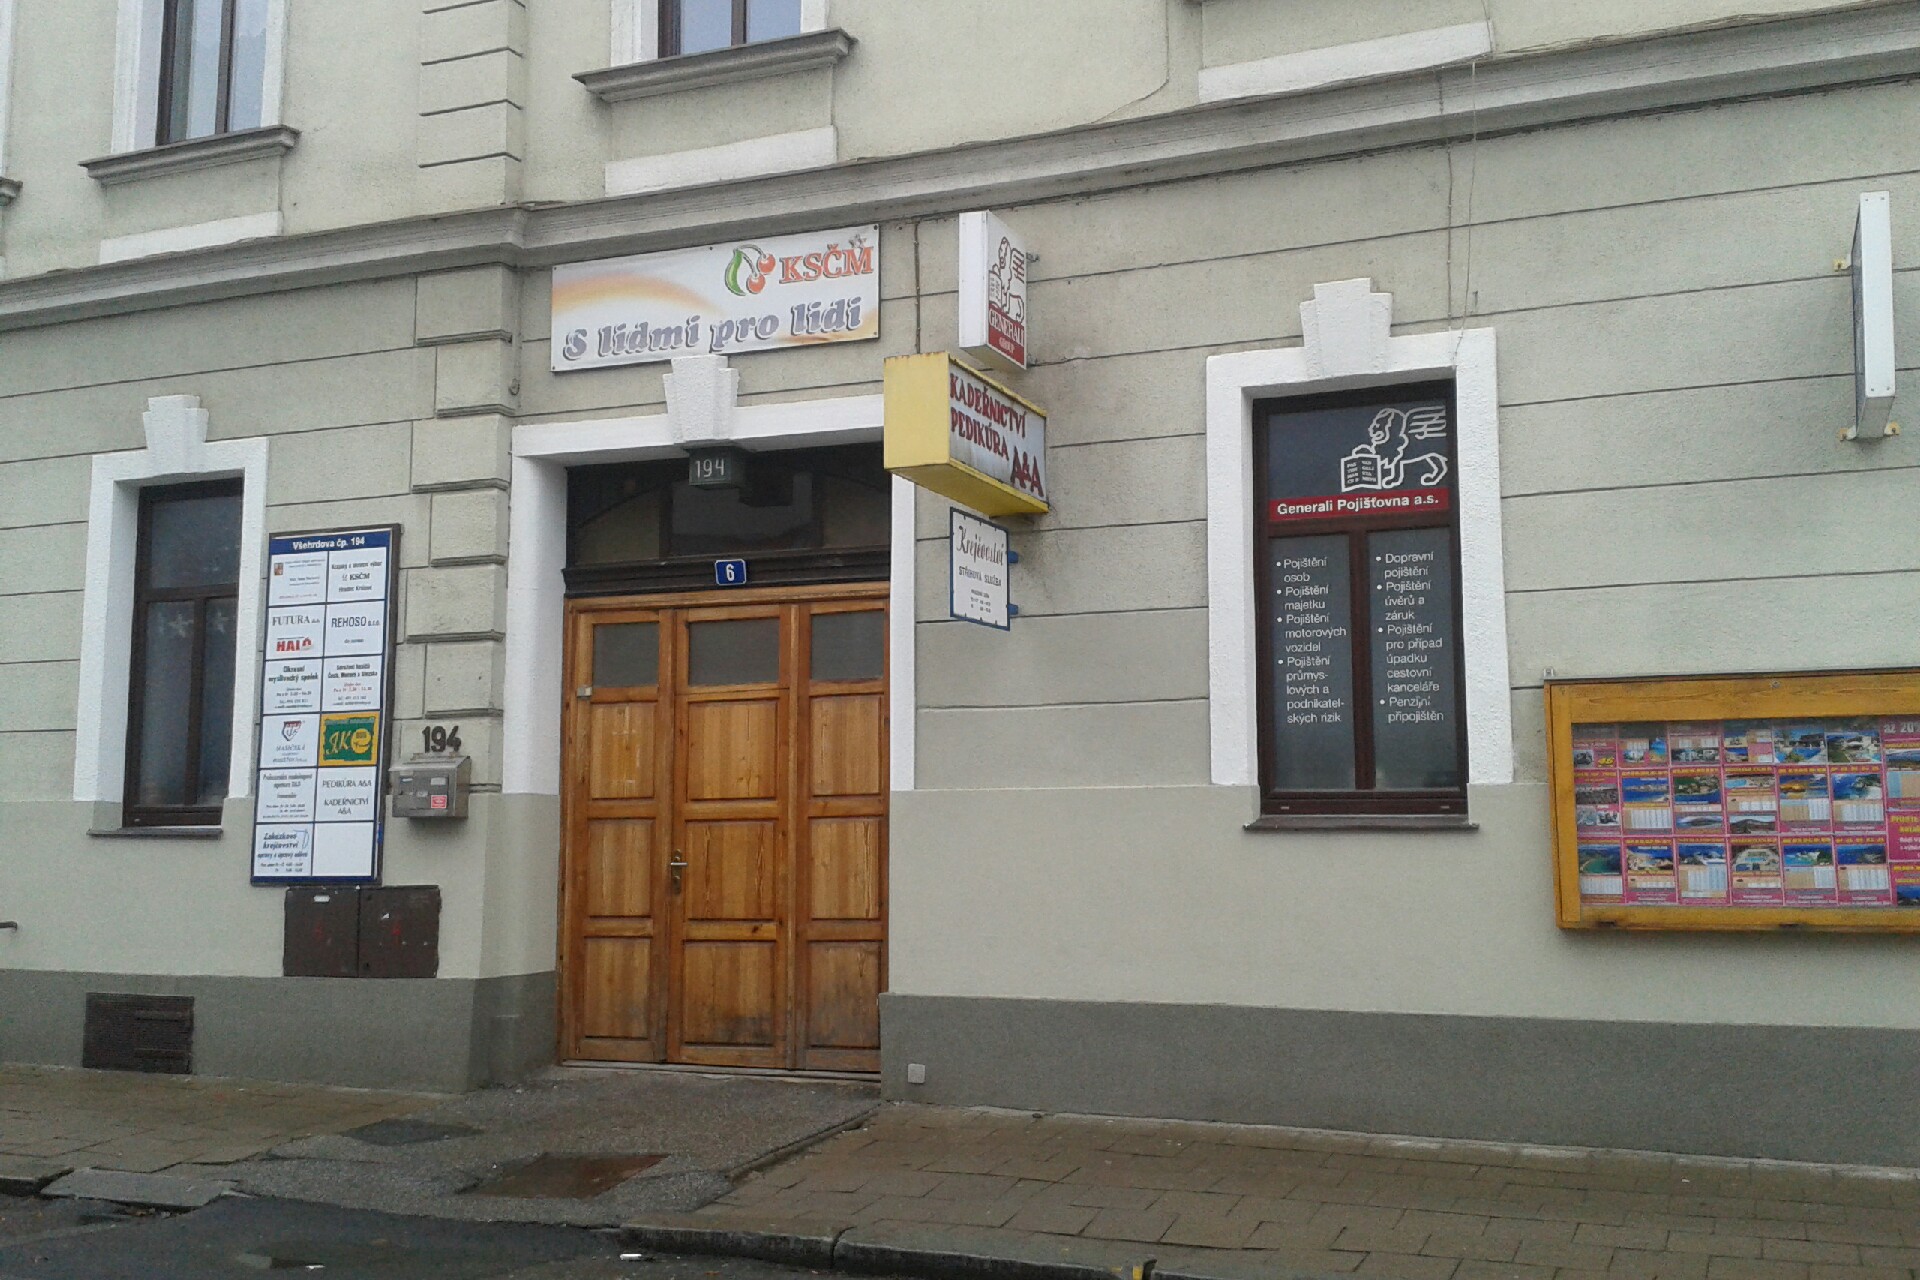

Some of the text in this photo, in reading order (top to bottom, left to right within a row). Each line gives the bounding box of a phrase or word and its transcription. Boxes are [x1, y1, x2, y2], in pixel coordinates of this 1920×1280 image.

[779, 244, 874, 285] KSČM
[563, 296, 862, 360] S lidmi pro lidi
[989, 308, 1025, 347] GENERALI
[950, 373, 1027, 438] KADEŘNICTVÍ
[951, 407, 1009, 461] PEDIKÚRA
[695, 458, 725, 478] 194
[1010, 446, 1044, 497] A&A
[1277, 494, 1439, 515] Generali Pojišťovna a.s.
[293, 536, 366, 550] Všehrdova čp. 194
[1283, 556, 1327, 570] Pojištění
[1385, 551, 1434, 565] Dopravní
[725, 563, 735, 581] 6
[1284, 572, 1310, 582] osob
[1384, 566, 1429, 580] pojištění
[1285, 584, 1328, 598] Pojištění
[1386, 580, 1431, 593] Pojištění
[1284, 600, 1326, 612] majetku
[1385, 594, 1425, 606] úvěrů a
[272, 614, 310, 626] FUTURA
[331, 616, 366, 628] REHOSO
[1286, 612, 1329, 626] Pojištění
[1385, 610, 1415, 621] záruk
[1285, 627, 1347, 639] motorových
[1387, 622, 1433, 636] Pojištění
[1285, 642, 1321, 652] vozidel
[1386, 637, 1443, 651] pro případ
[1287, 655, 1331, 668] Pojištění
[1386, 653, 1428, 665] úpadku
[1286, 670, 1329, 682] průmys-
[1387, 667, 1432, 679] cestovní
[1286, 685, 1329, 696] lových a
[1387, 682, 1440, 693] kanceláře
[1286, 698, 1344, 712] podnikatel-
[1389, 696, 1431, 708] Penzijní
[1287, 712, 1342, 726] ských rizik
[422, 725, 462, 753] 194
